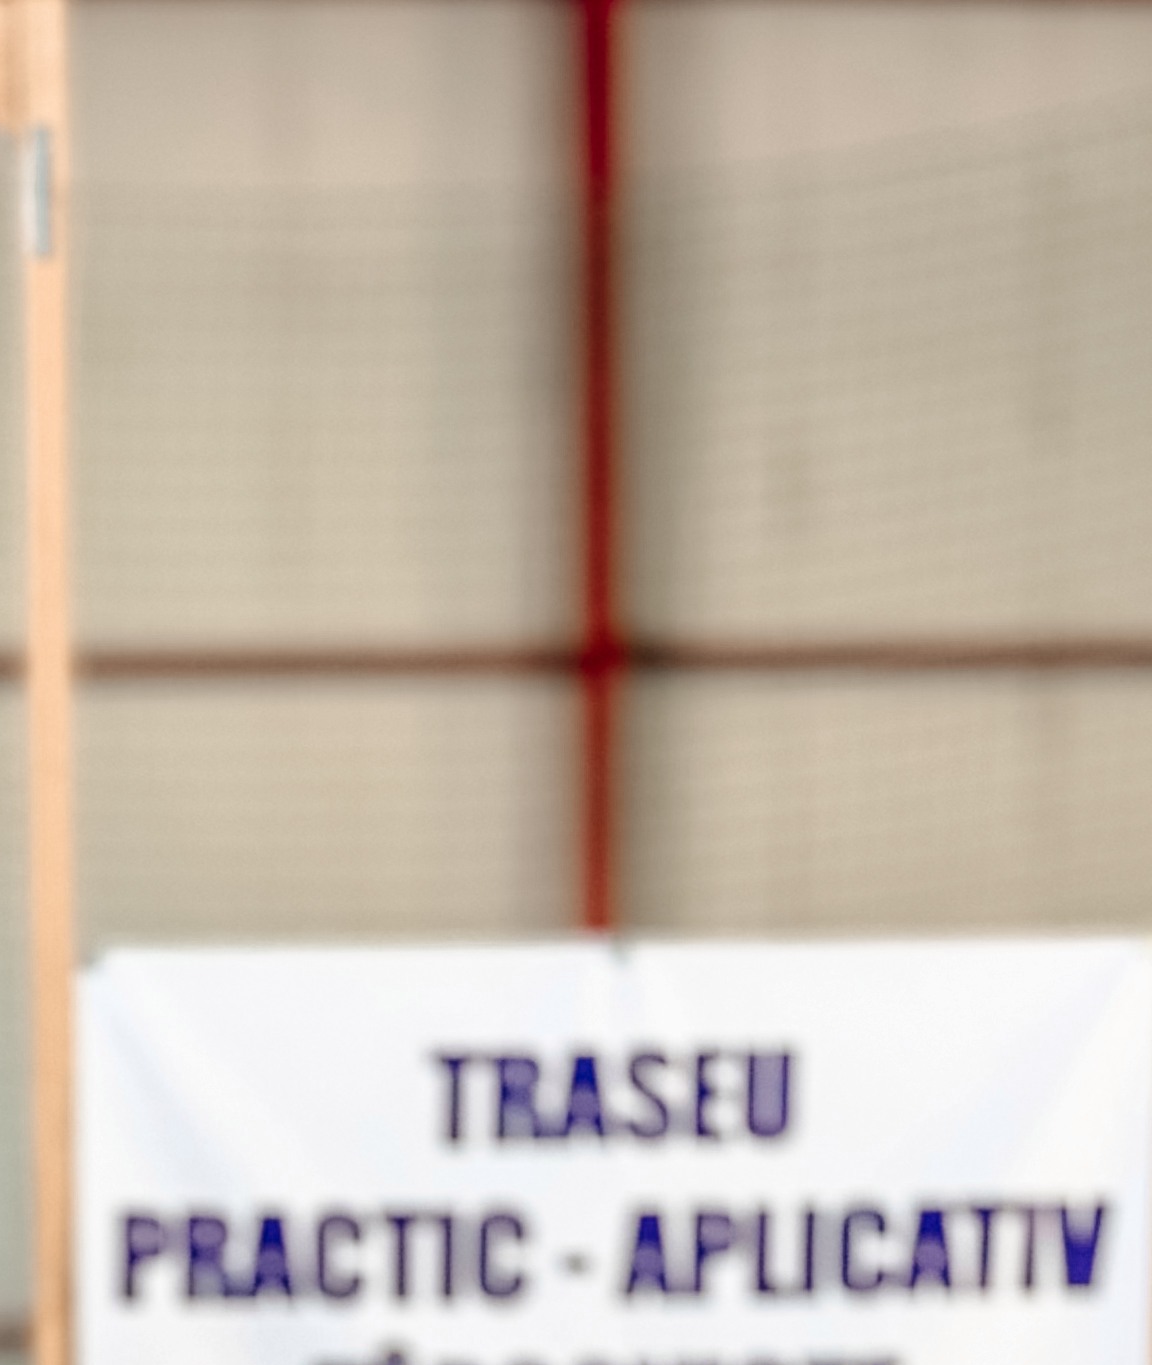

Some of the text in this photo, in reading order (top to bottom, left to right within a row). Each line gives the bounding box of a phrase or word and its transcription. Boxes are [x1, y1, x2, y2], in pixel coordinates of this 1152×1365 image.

[432, 1045, 798, 1150] TRASEU
[115, 1204, 532, 1309] PRACTIC
[616, 1198, 1113, 1305] APLICATIV
